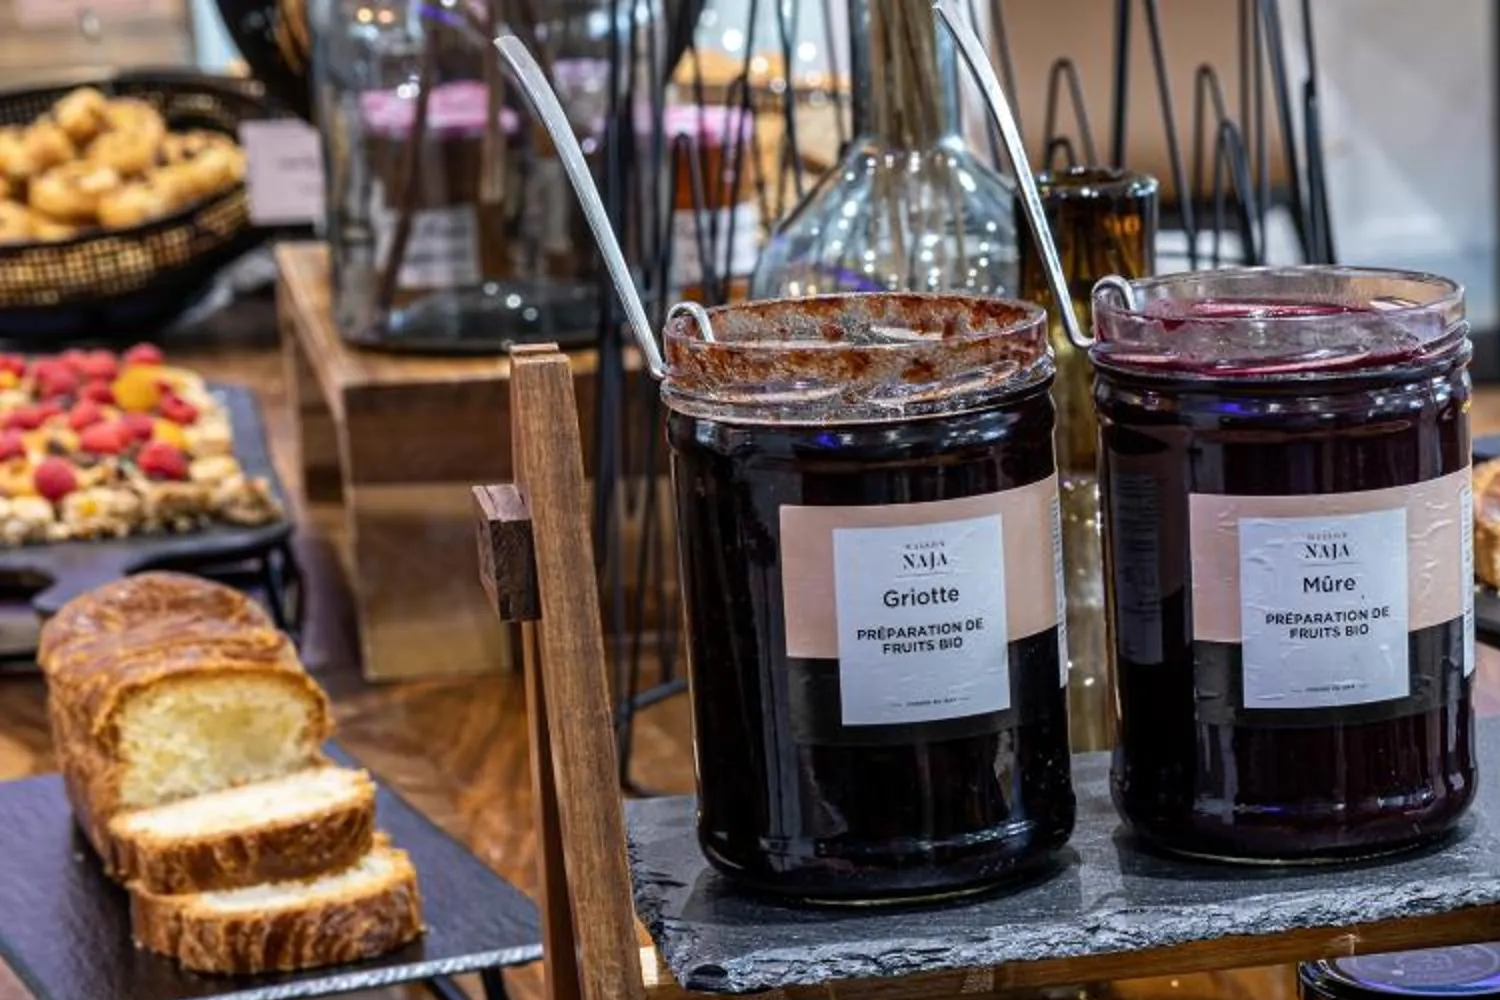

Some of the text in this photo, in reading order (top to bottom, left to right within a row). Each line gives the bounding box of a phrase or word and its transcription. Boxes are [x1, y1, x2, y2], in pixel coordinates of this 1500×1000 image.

[1305, 544, 1350, 559] NAJA
[903, 553, 948, 570] NAJA
[1304, 575, 1356, 593] Mûre
[883, 587, 960, 608] Griotte
[1266, 607, 1389, 625] PRÉPARATION DE
[857, 618, 984, 641] PRÉPARATION DE
[1289, 624, 1368, 639] FRUITS BIO
[883, 636, 963, 654] FRUITS BIO
